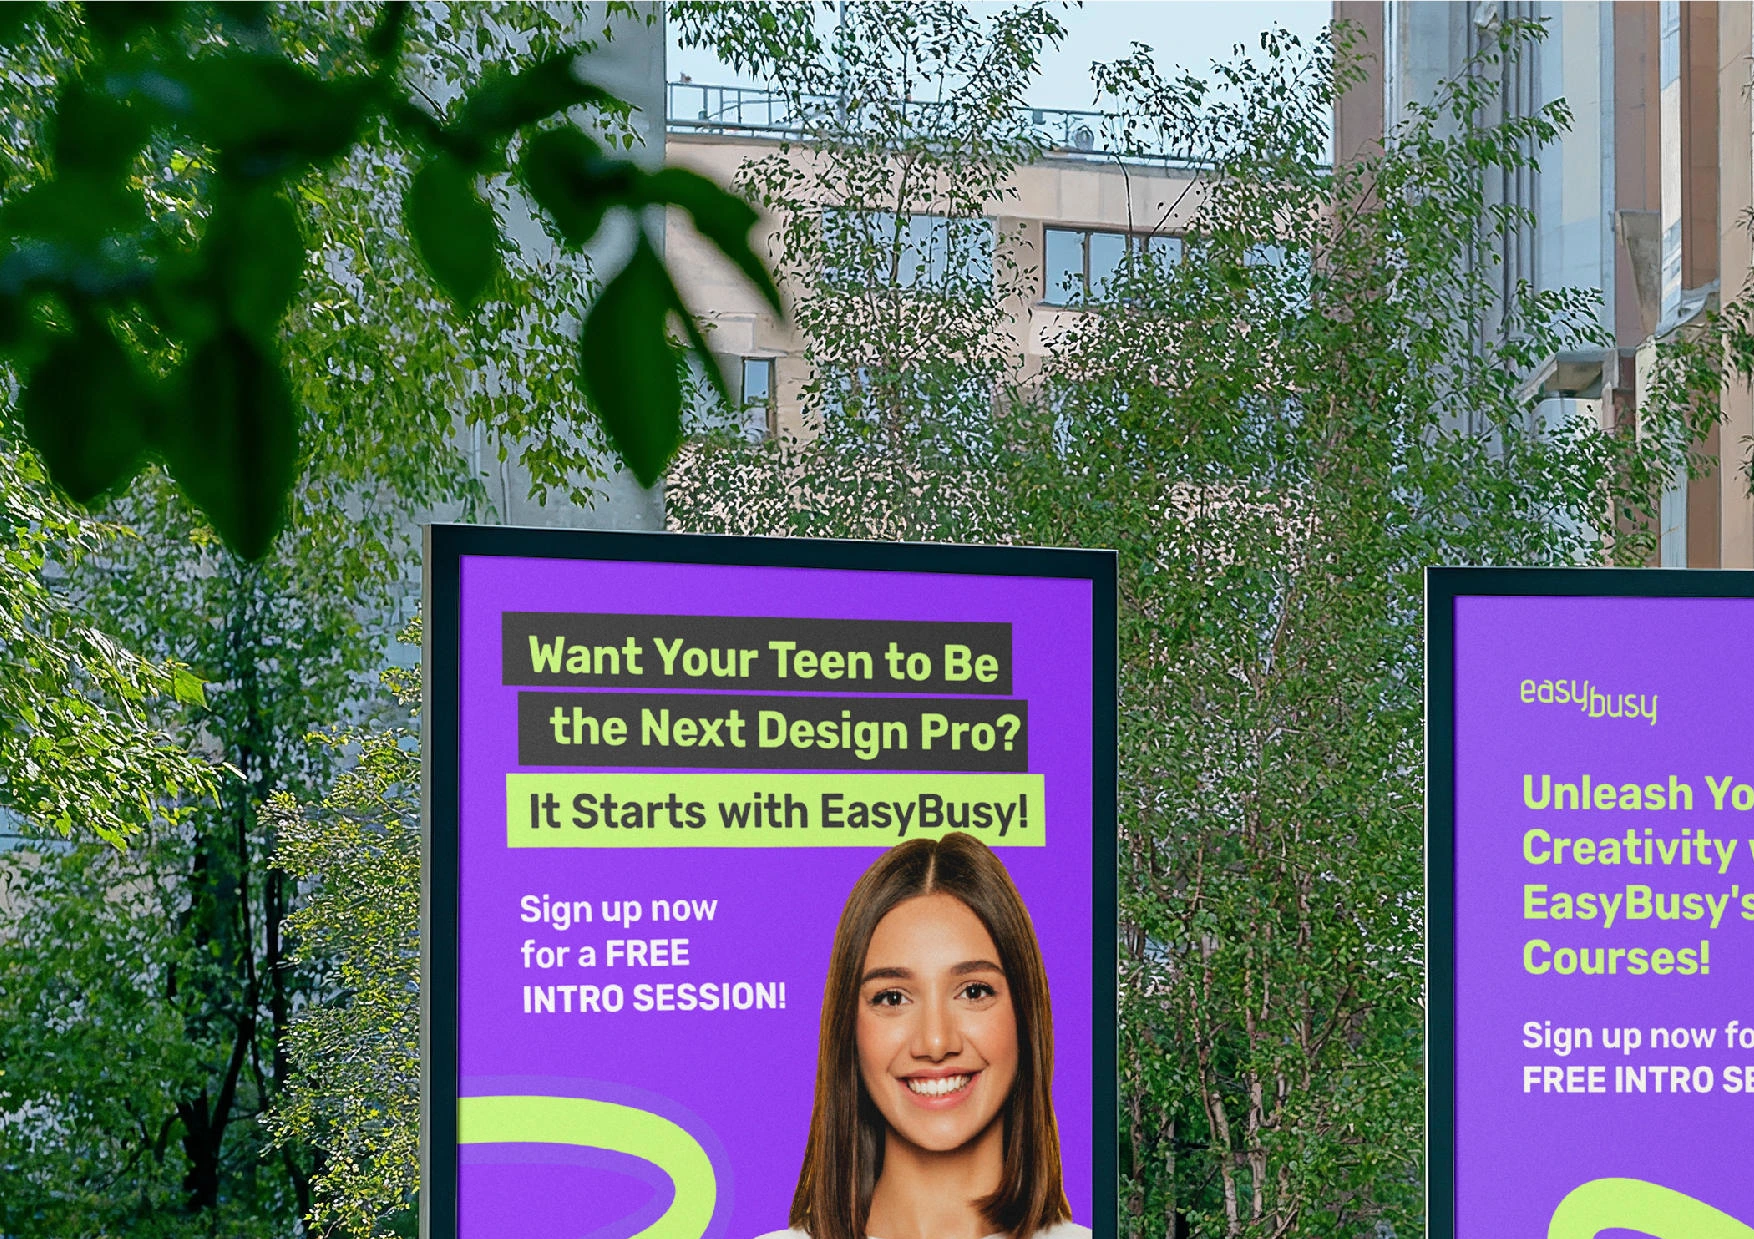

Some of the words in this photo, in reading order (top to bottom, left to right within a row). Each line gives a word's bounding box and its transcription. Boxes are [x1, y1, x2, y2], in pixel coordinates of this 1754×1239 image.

[527, 633, 643, 675] Want
[653, 638, 758, 676] Your
[769, 641, 872, 678] Teen
[885, 642, 931, 680] to
[945, 645, 998, 681] Be
[550, 707, 627, 744] the
[642, 709, 745, 746] Next
[759, 710, 907, 759] Design
[922, 713, 1020, 750] Pro?
[1524, 774, 1692, 809] Unleash
[531, 793, 561, 827] It
[573, 794, 706, 828] Starts
[719, 792, 808, 827] with
[822, 794, 1027, 837] EasyBusy!
[1524, 828, 1737, 873] Creativity
[521, 894, 592, 930] Sign
[602, 901, 642, 927] up
[652, 900, 717, 920] now
[521, 940, 570, 967] for
[578, 946, 596, 966] a
[607, 939, 689, 965] FREE
[1524, 939, 1709, 974] Courses!
[524, 984, 623, 1012] INTRO
[633, 982, 785, 1010] SESSION!
[1523, 1021, 1592, 1055] Sign
[1603, 1028, 1641, 1054] up
[1651, 1028, 1716, 1047] now
[1524, 1066, 1605, 1092] FREE
[1616, 1066, 1713, 1092] INTRO
